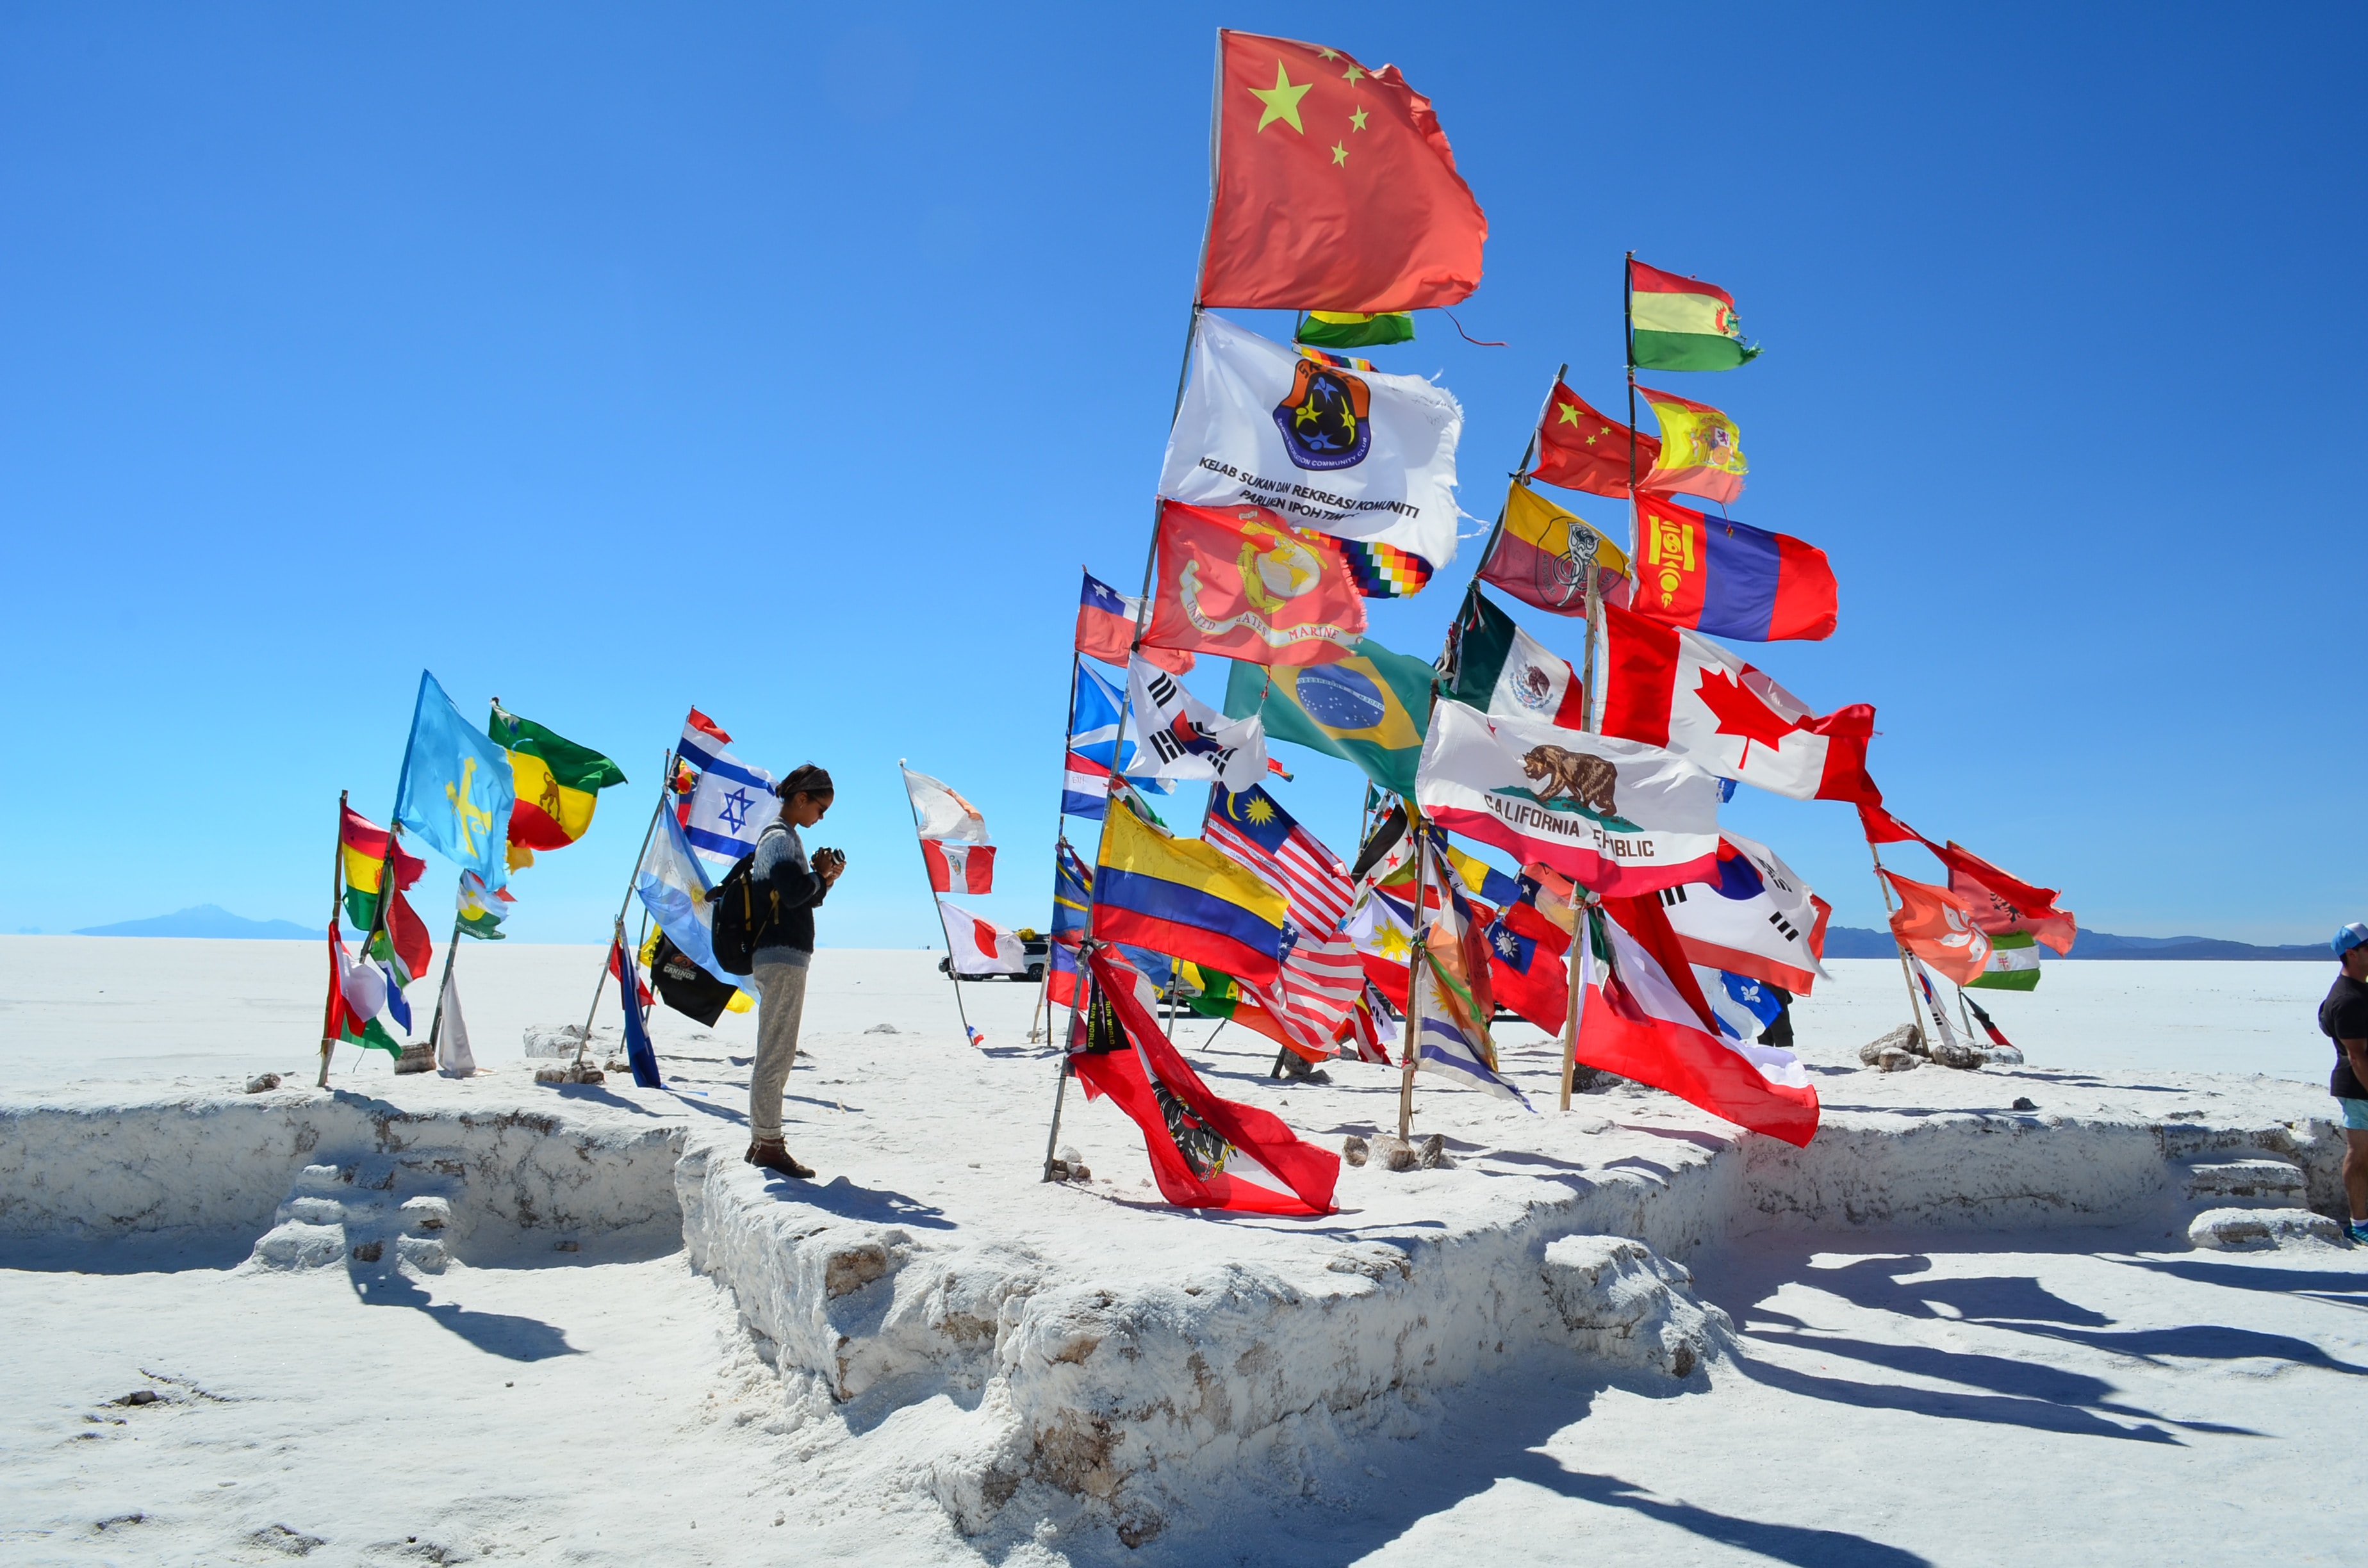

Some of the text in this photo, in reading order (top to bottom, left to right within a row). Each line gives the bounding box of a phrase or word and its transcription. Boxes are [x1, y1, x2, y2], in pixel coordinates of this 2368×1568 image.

[1311, 455, 1356, 467] COMMUNITY
[1357, 437, 1367, 457] CLUB
[1199, 456, 1420, 519] KELAB SUKAN DAN REKREASI KOMUNITI
[1287, 500, 1322, 519] IPOH
[1321, 510, 1360, 521] TIM
[1542, 553, 1557, 596] REGIONE
[1186, 600, 1216, 631] UNITED
[1288, 626, 1340, 641] MARINE
[1484, 794, 1580, 838] CALIFORNIA
[662, 965, 696, 981] CANINOS
